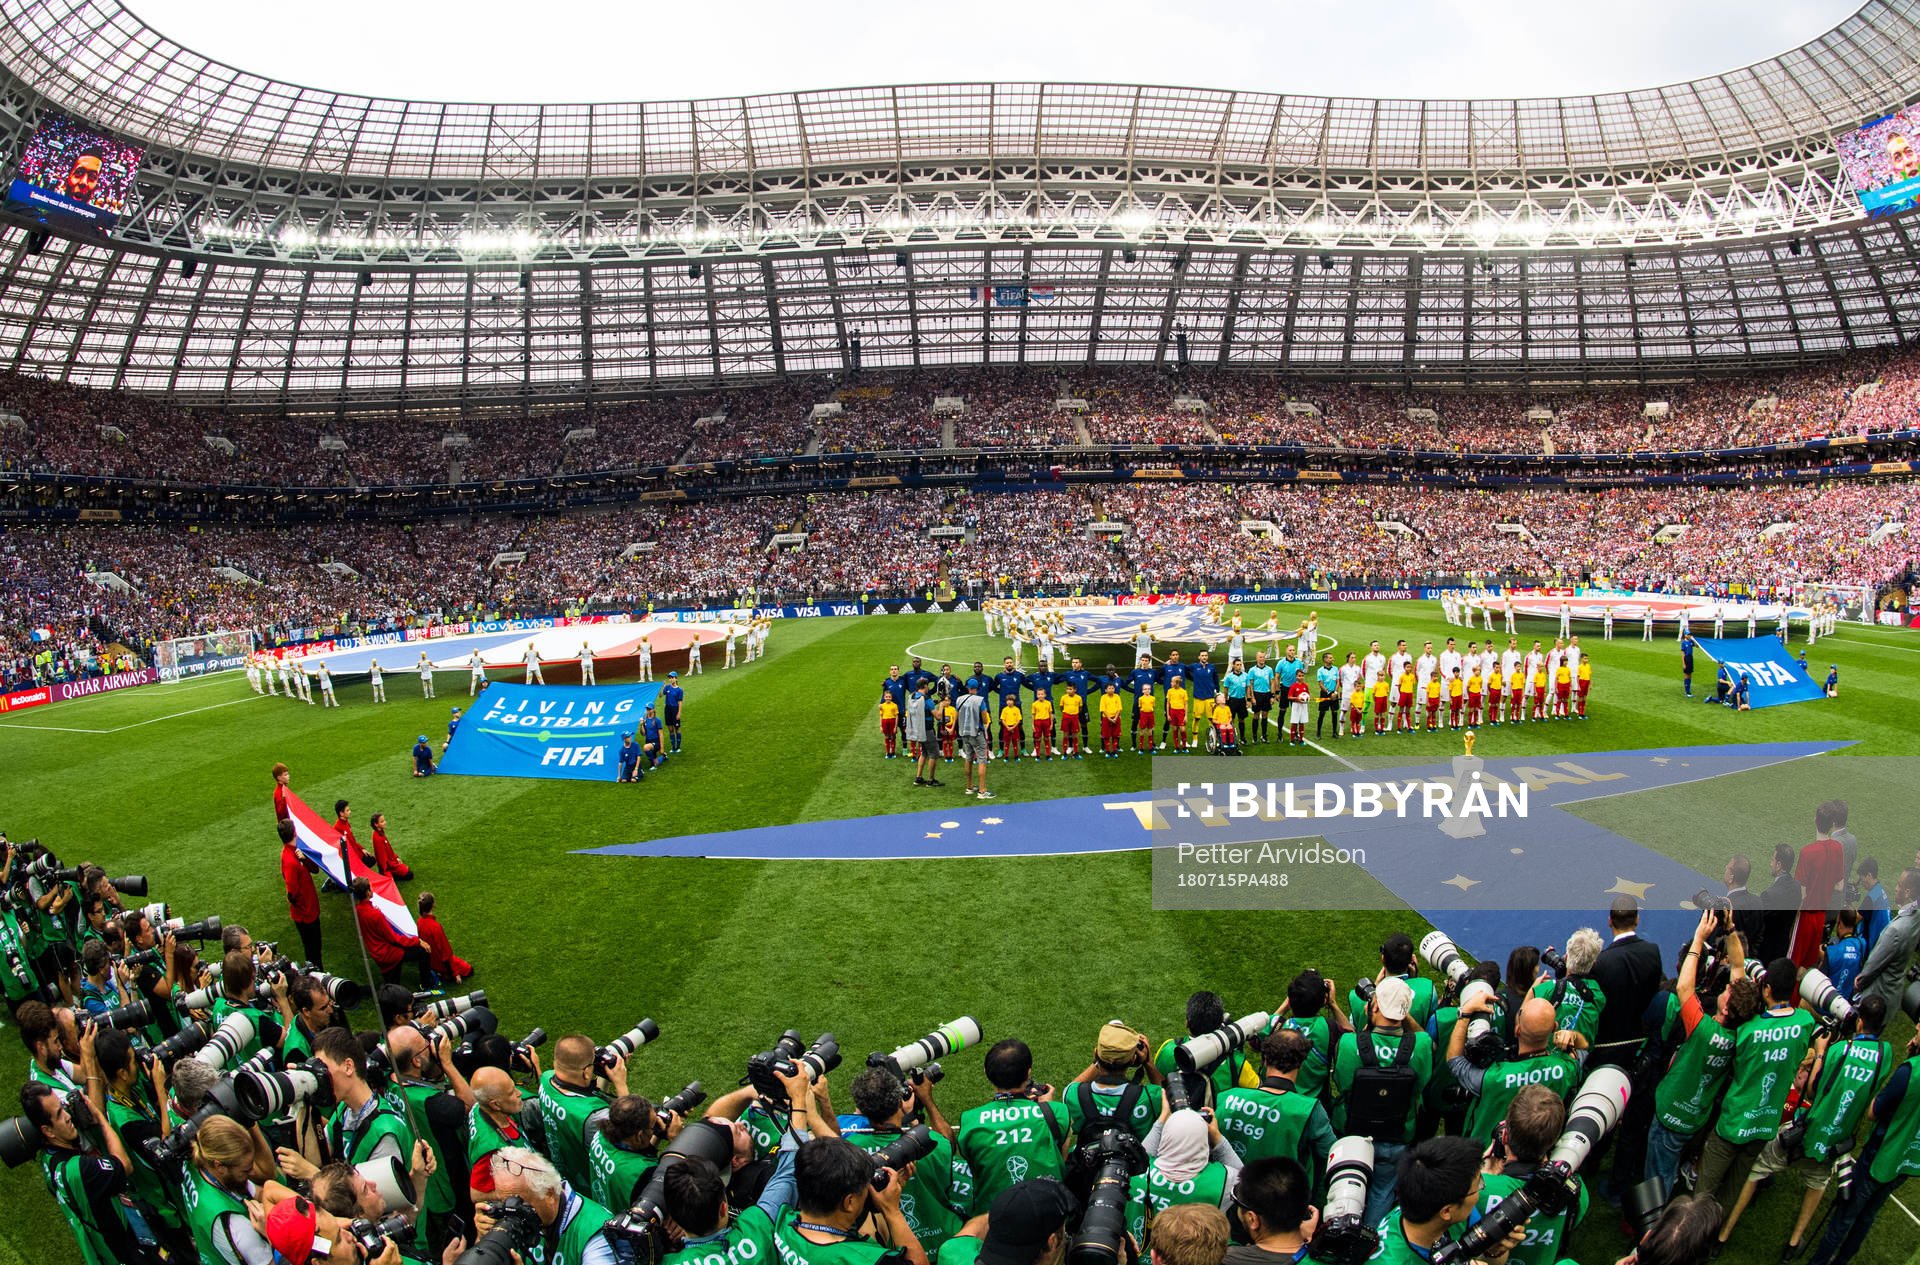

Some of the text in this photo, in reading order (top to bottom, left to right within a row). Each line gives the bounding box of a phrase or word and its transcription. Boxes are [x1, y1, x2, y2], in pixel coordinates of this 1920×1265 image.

[1339, 590, 1412, 601] QATAR AIRWAYS
[757, 608, 784, 618] VISA
[793, 606, 821, 618] VISA
[830, 605, 858, 616] VISA
[62, 670, 148, 699] QATAR AIRWAYS
[11, 692, 47, 706] McDonald's
[494, 697, 635, 715] LIVING
[541, 746, 607, 767] FIFA
[1709, 1033, 1735, 1050] PHO
[1753, 1024, 1801, 1043] PHOTO
[1763, 1048, 1788, 1063] 148
[1505, 1065, 1564, 1089] PHOTO
[1843, 1064, 1874, 1082] 1127
[979, 1105, 1045, 1125] PHOTO
[1225, 1094, 1281, 1123] PHOTO
[996, 1127, 1033, 1145] 212
[1223, 1118, 1265, 1141] 1369
[1521, 1229, 1554, 1246] 24
